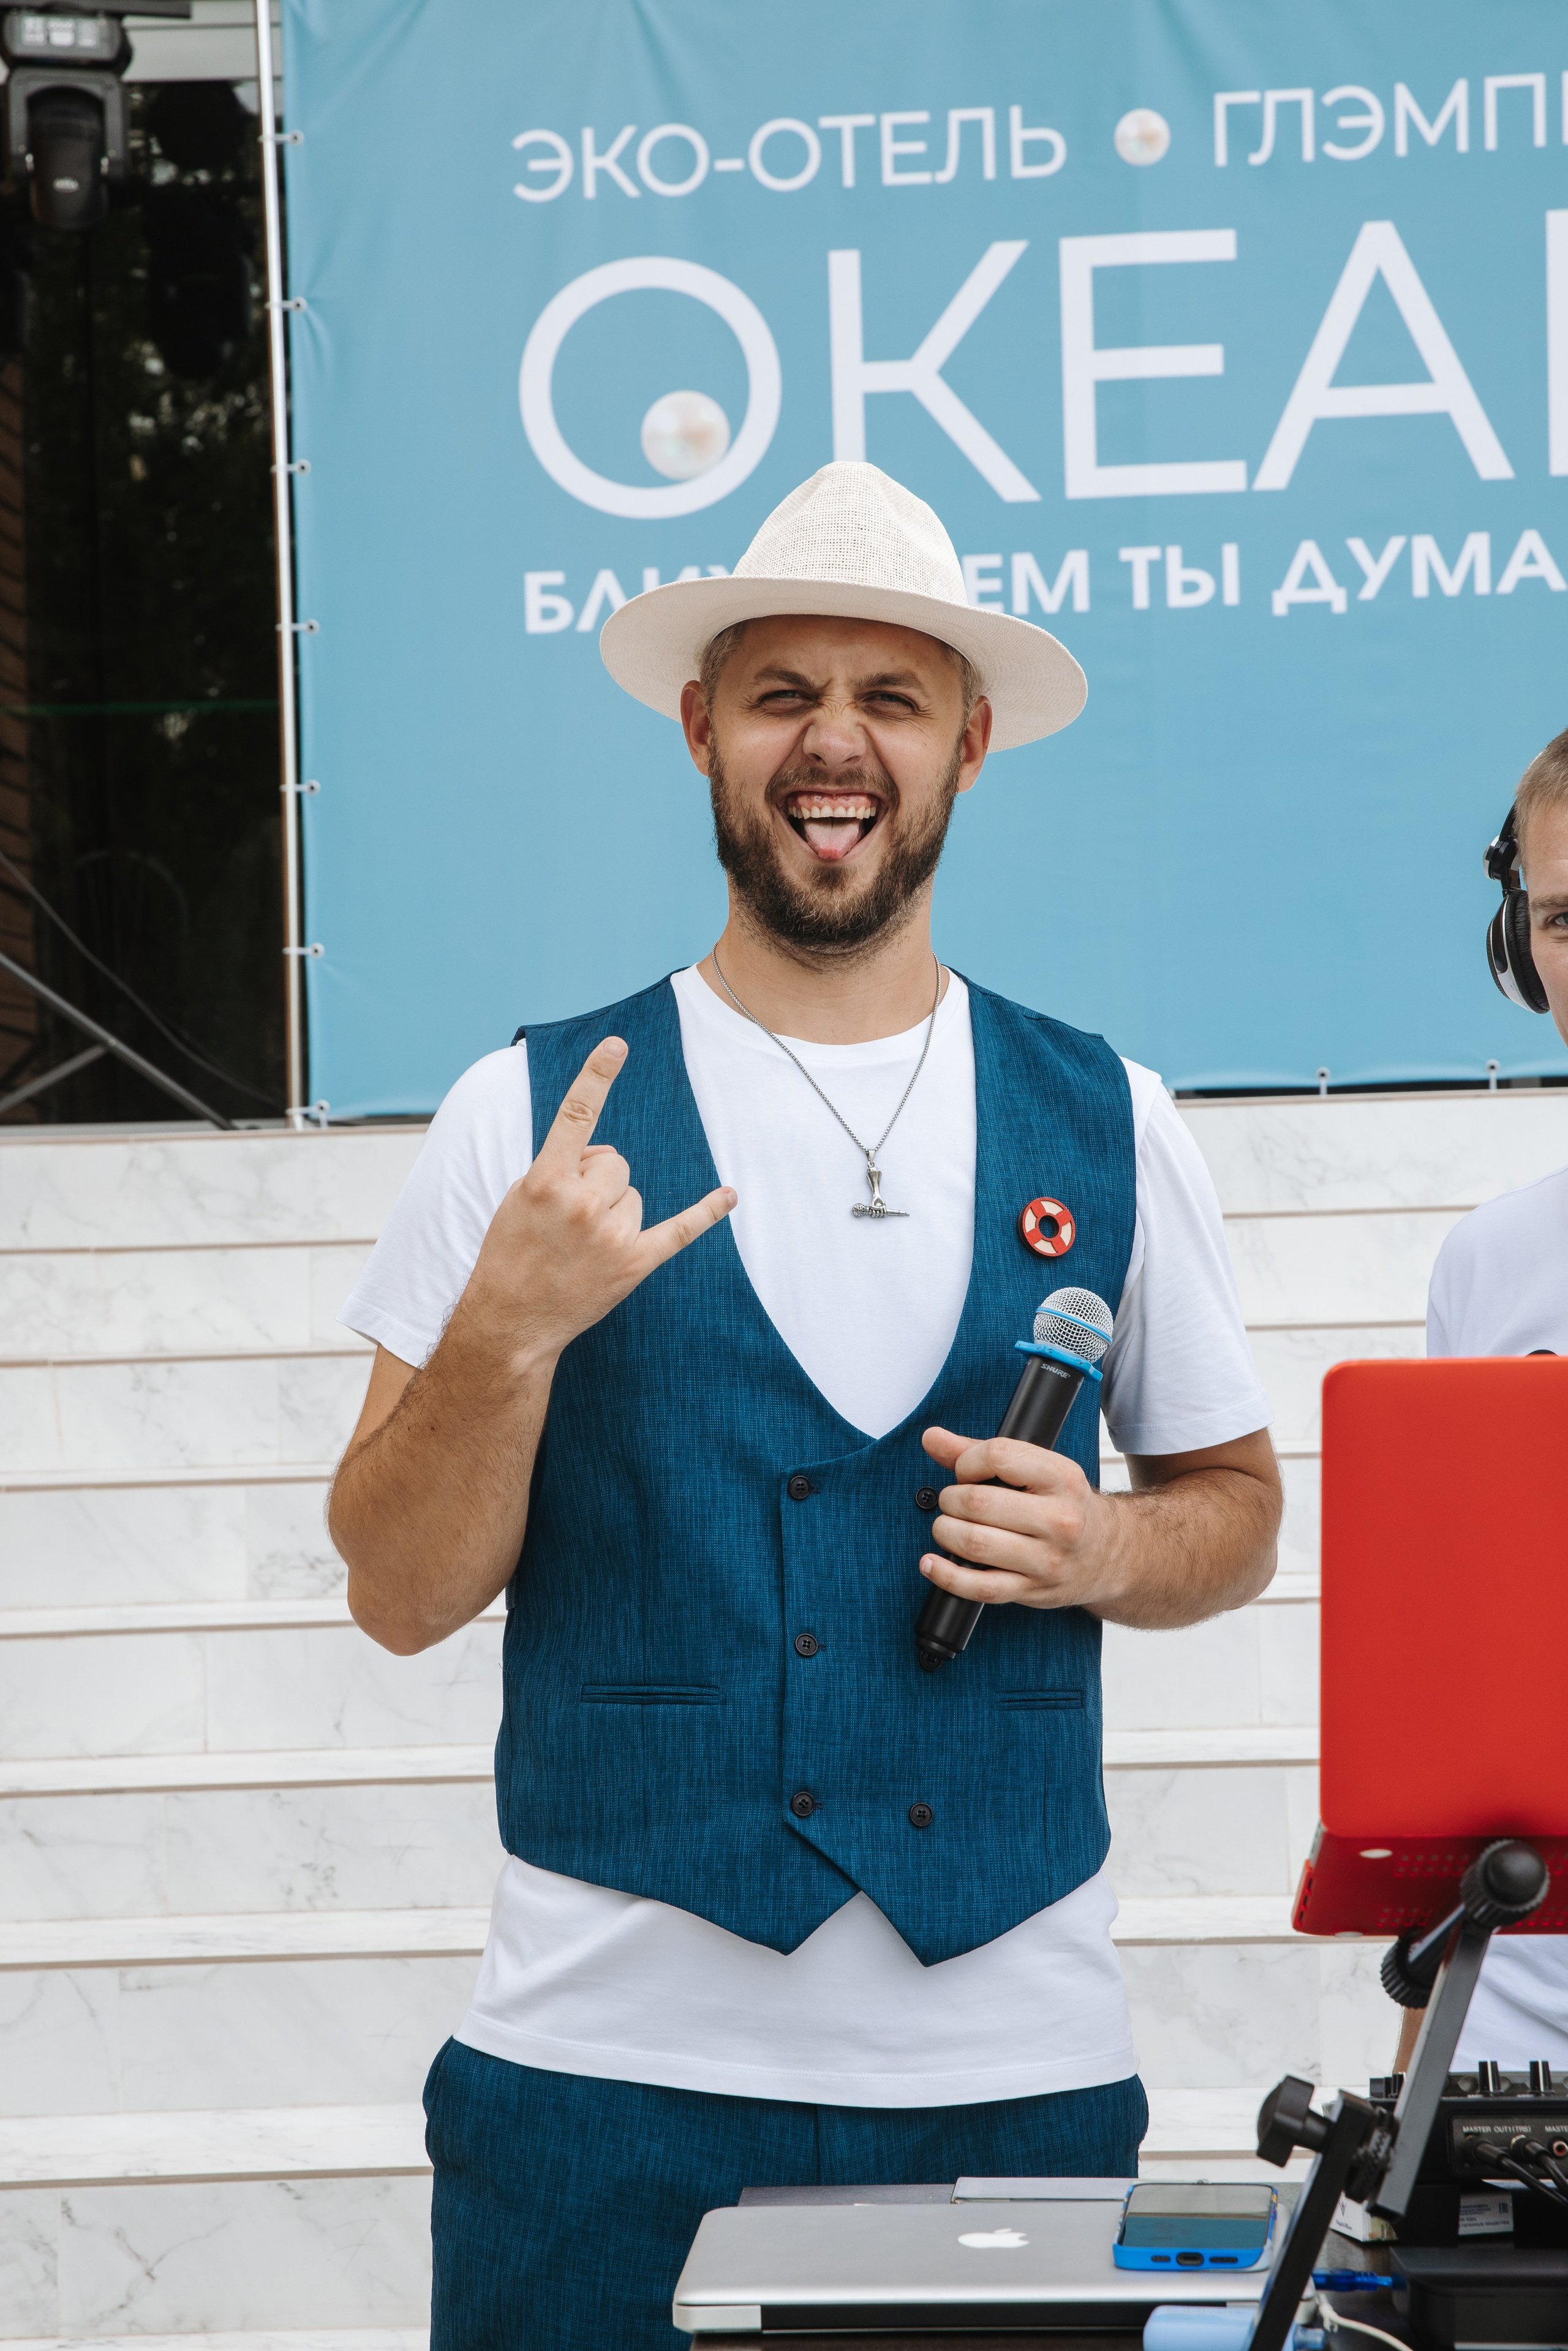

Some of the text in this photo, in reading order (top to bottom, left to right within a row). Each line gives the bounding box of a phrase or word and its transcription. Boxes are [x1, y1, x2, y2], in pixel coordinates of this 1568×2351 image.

[511, 105, 1067, 202] ЭКО-ОТЕЛЬ
[524, 529, 1568, 635] БЛ ЕМ ТЫ ДУМА
[1041, 1363, 1069, 1379] SHURE
